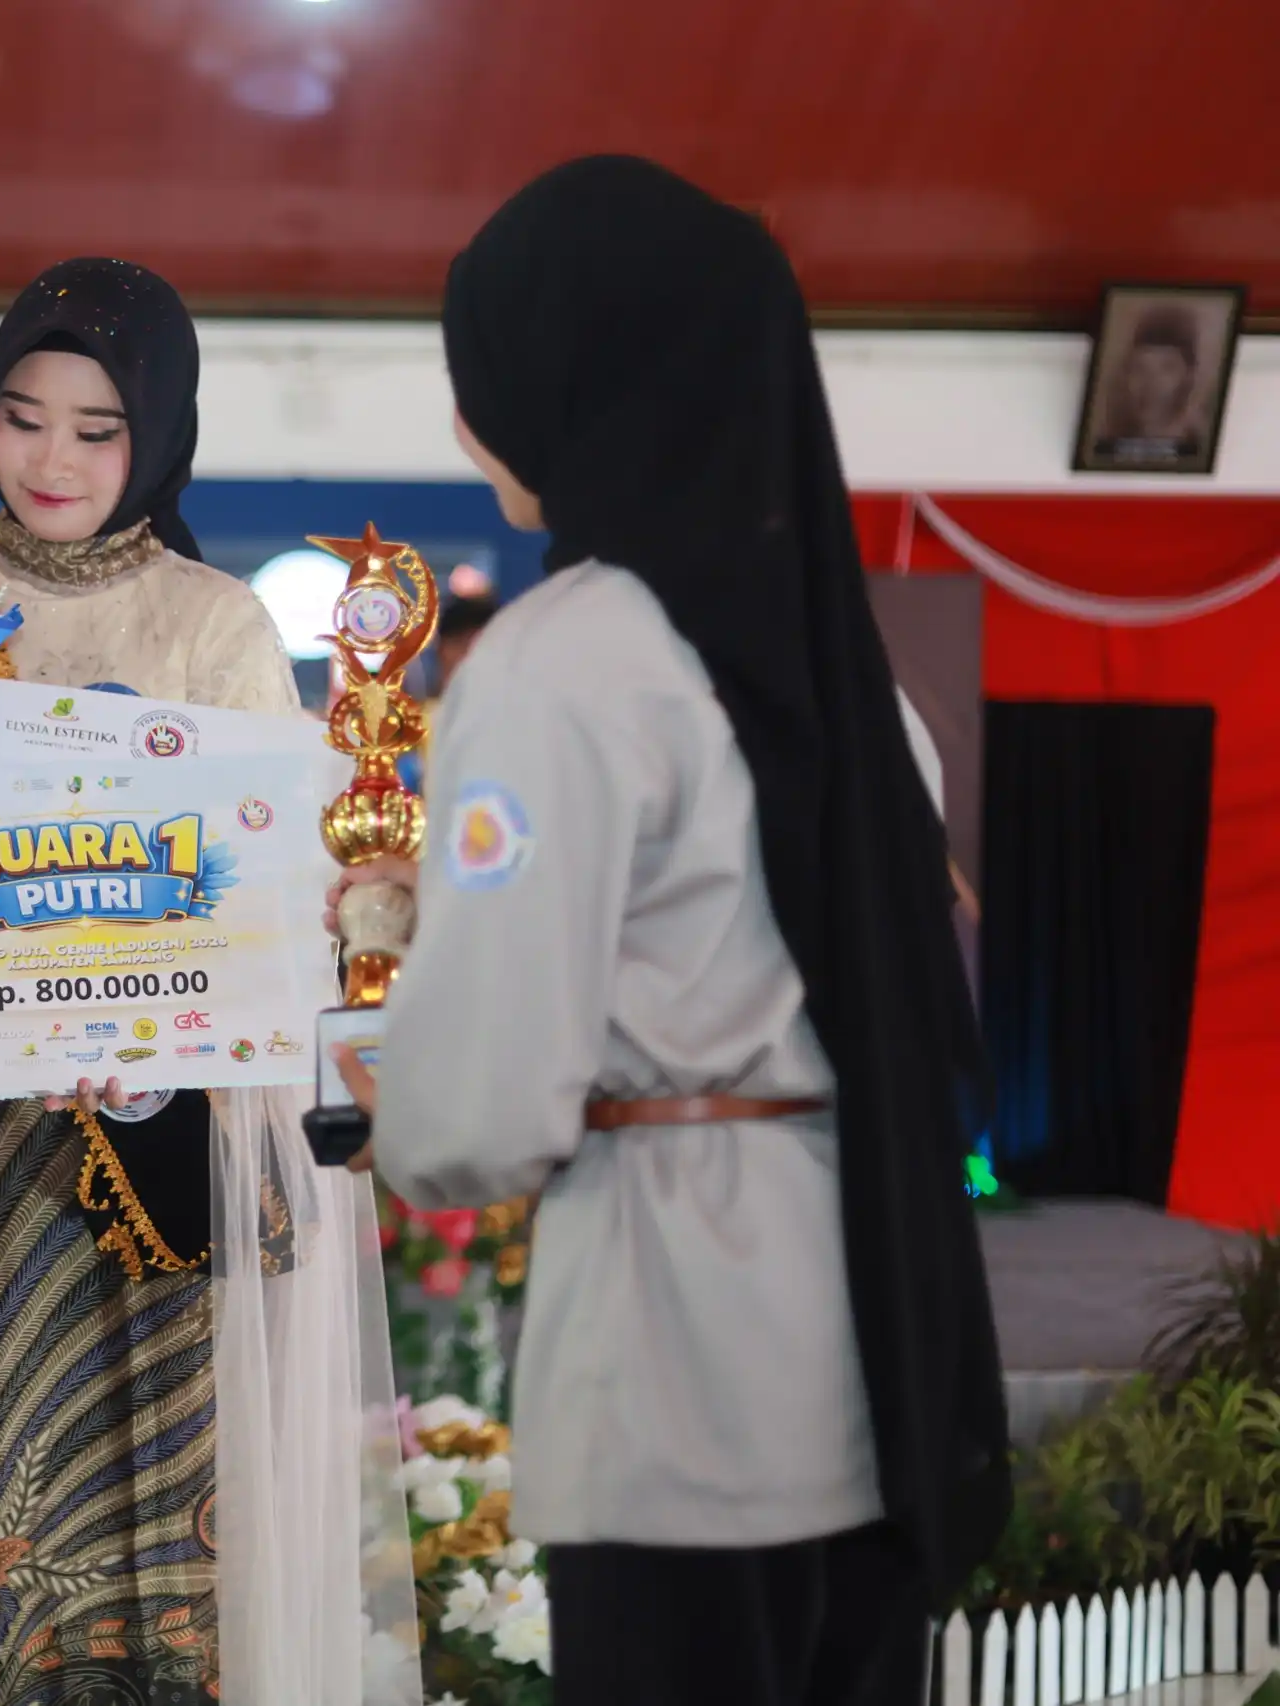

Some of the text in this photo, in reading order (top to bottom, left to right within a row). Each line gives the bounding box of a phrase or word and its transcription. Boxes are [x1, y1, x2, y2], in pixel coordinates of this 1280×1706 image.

[6, 719, 119, 745] ELYSIA ESTETIKA
[158, 814, 199, 877] 1
[15, 878, 142, 917] PUTRI
[8, 950, 176, 972] KABUPATEN SAMPANG
[11, 946, 51, 958] DUTA
[56, 941, 106, 956] GENRE
[35, 970, 209, 1003] 800.000.00
[85, 1021, 119, 1031] HCML
